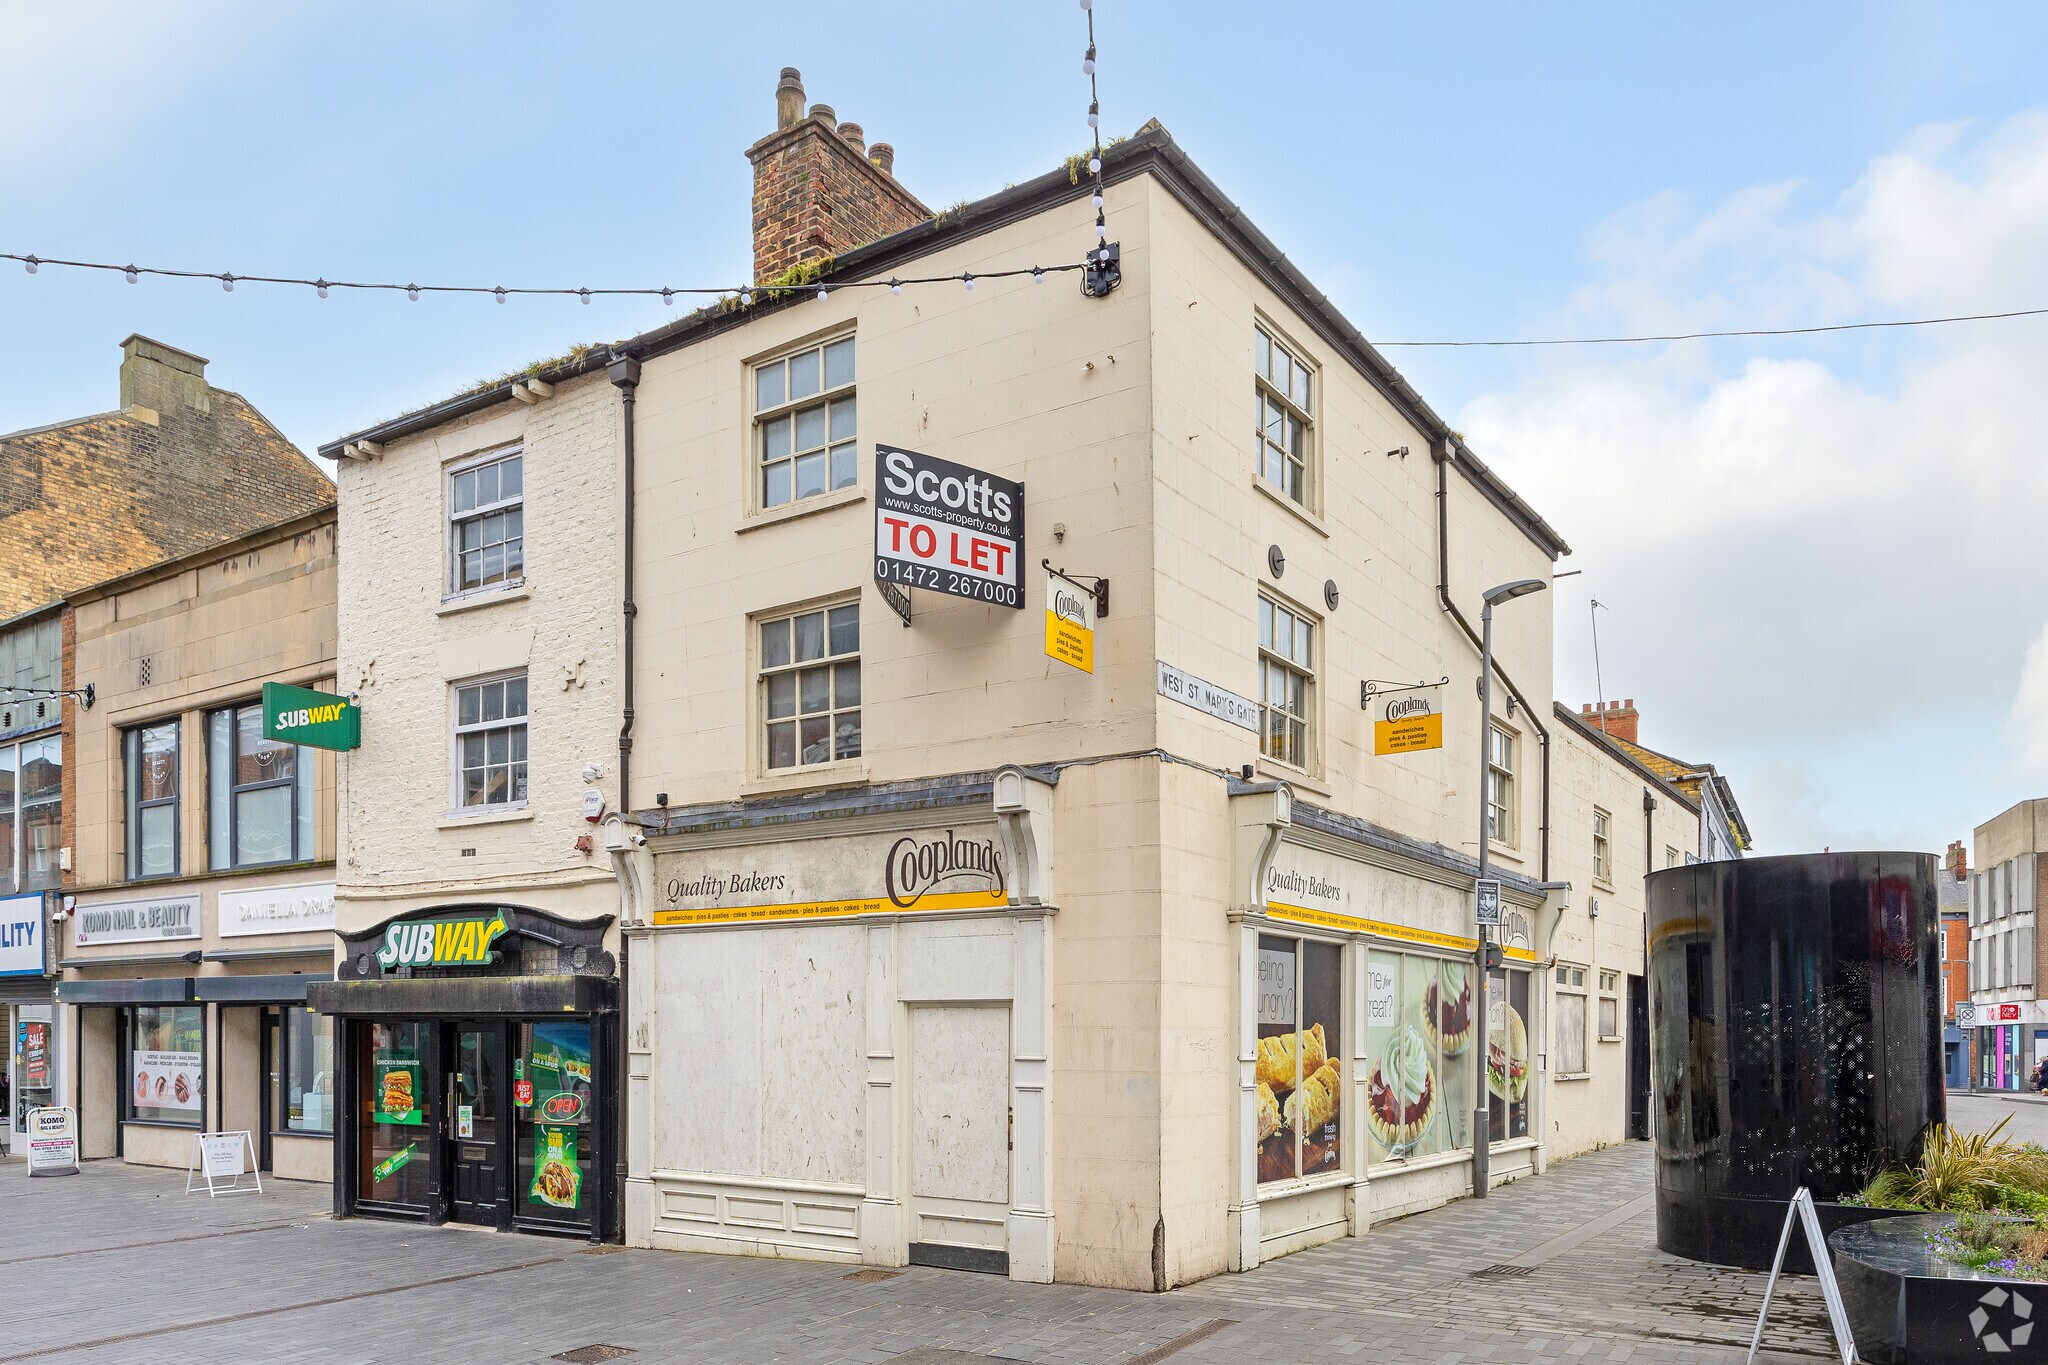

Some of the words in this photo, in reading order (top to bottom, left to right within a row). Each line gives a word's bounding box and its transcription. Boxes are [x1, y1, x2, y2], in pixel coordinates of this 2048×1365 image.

[884, 452, 1012, 522] Scotts
[884, 496, 1010, 536] www.scotts-property.co.uk
[884, 517, 937, 558] TO
[950, 532, 1010, 576] LET
[877, 559, 939, 589] 01472
[948, 574, 1016, 605] 267000
[1056, 638, 1065, 646] pies
[1070, 644, 1084, 654] pasties
[1058, 630, 1082, 645] sandwiches
[1056, 647, 1068, 656] cakes
[1072, 652, 1082, 662] bread
[1162, 670, 1184, 694] WEST
[1205, 690, 1234, 715] MARY'S
[1238, 704, 1256, 724] GATE
[1386, 696, 1430, 724] Cooplands
[275, 702, 346, 730] SUBWAY
[1392, 726, 1424, 735] sandwiches
[1390, 740, 1406, 748] cakes
[886, 830, 1004, 908] Cooplands
[1267, 866, 1308, 899] Quality
[1308, 876, 1341, 901] Bakers
[667, 875, 726, 903] Quality
[729, 871, 786, 894] Bakers
[82, 910, 110, 934] KOMO
[113, 908, 136, 930] NAIL
[139, 912, 146, 928] &
[148, 904, 191, 928] BEAUTY
[666, 913, 693, 921] sandwiches
[696, 912, 706, 920] pies
[712, 912, 729, 920] pasties
[769, 908, 799, 916] sandwiches
[803, 906, 814, 915] pies
[820, 905, 840, 914] pasties
[844, 904, 859, 912] cakes
[0, 921, 35, 948] LITY
[376, 916, 506, 966] SUBWAY
[1258, 954, 1284, 989] eling
[28, 1032, 44, 1046] SALE
[548, 1098, 578, 1112] OPEN
